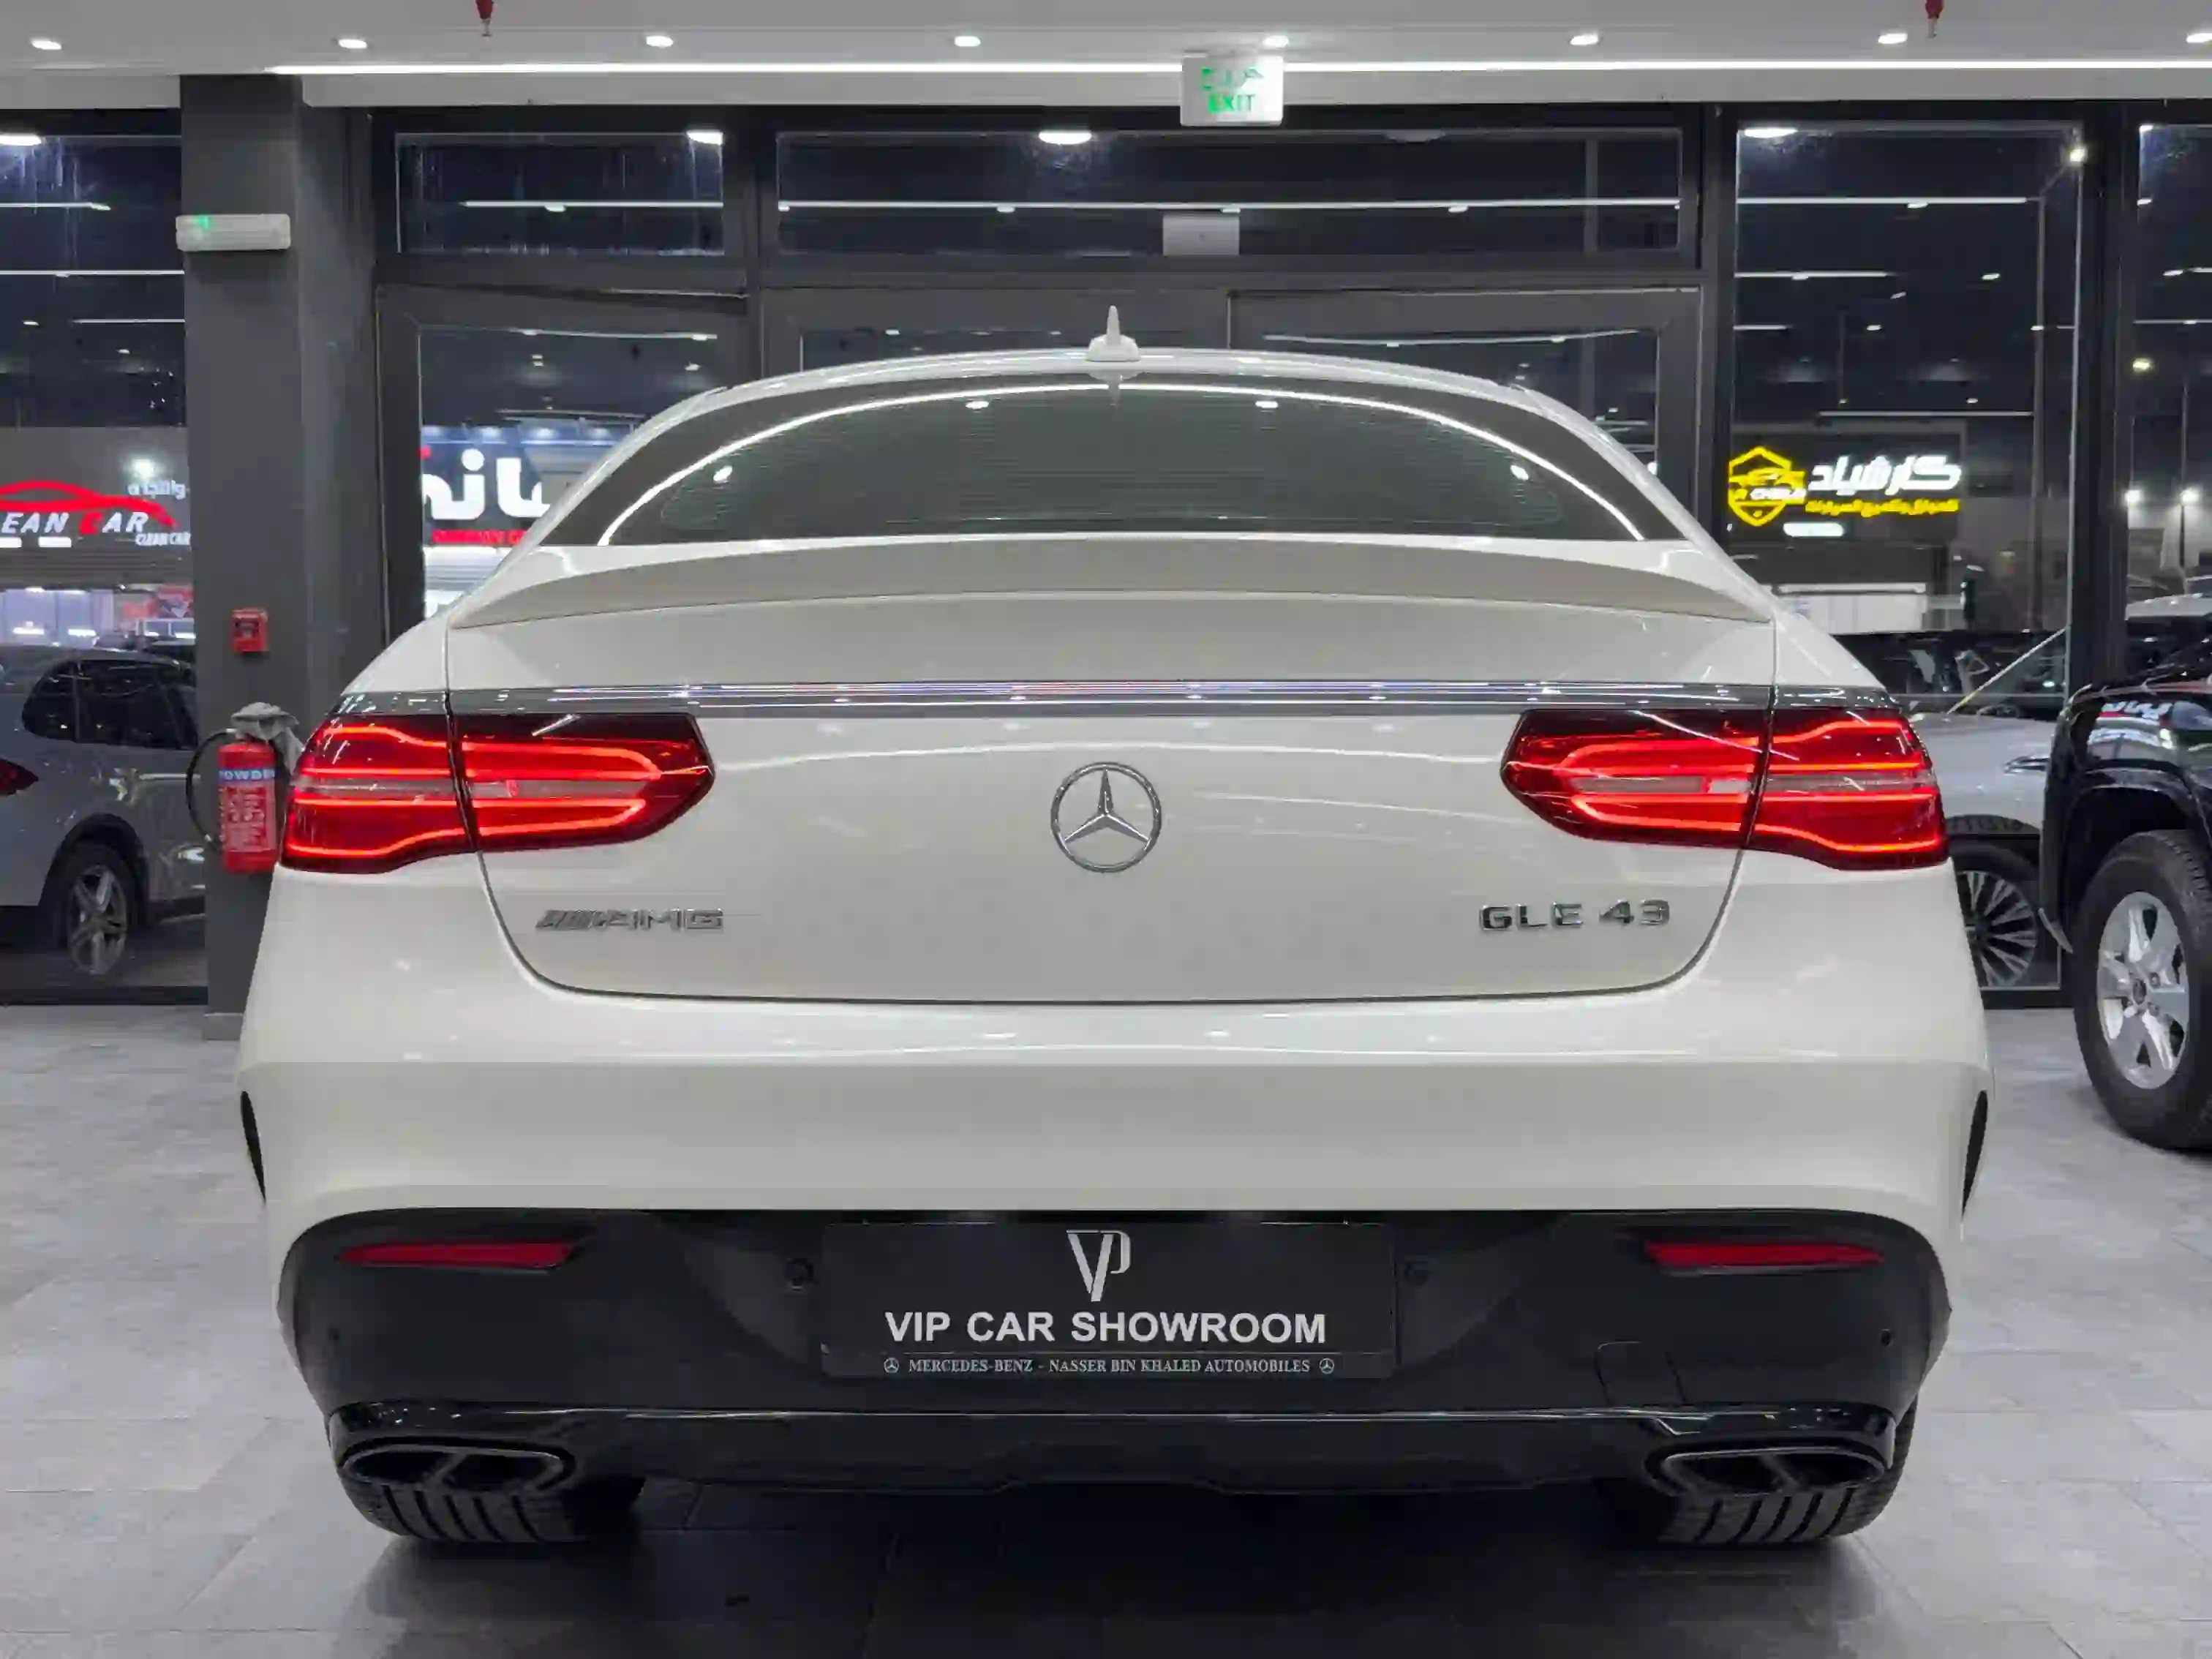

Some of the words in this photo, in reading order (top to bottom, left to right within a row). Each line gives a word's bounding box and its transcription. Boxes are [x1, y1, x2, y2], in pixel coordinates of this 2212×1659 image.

[1208, 92, 1256, 113] EXIT
[78, 511, 149, 535] CAR
[1479, 903, 1584, 930] GLE
[1599, 899, 1670, 927] 43
[884, 1312, 951, 1342] VIP
[966, 1311, 1056, 1342] CAR
[1071, 1311, 1326, 1344] SHOWROOM
[908, 1358, 1034, 1373] MERCEDES-BENZ
[1049, 1358, 1106, 1373] NASSER
[1110, 1358, 1136, 1373] BIN
[1140, 1358, 1201, 1373] KHALED
[1204, 1358, 1311, 1374] AUTOMOBILES
